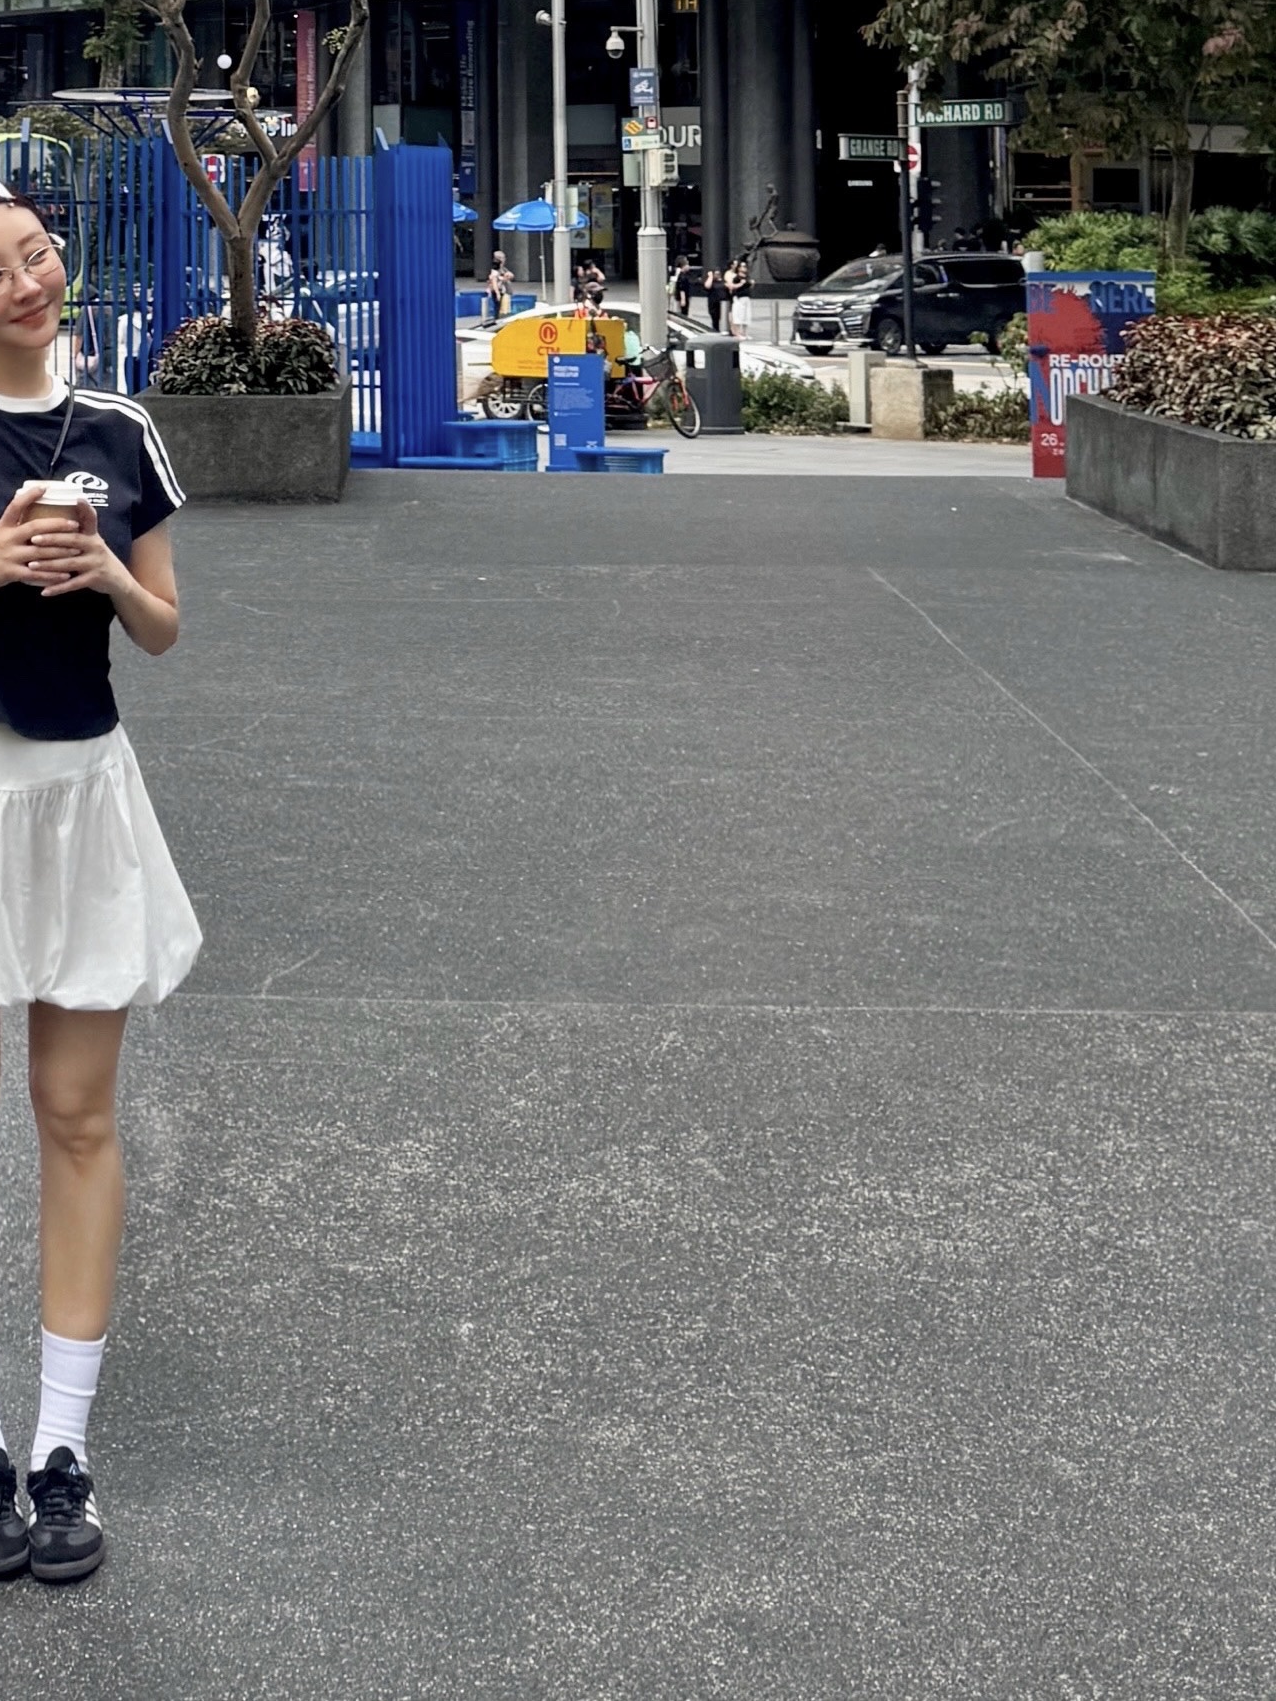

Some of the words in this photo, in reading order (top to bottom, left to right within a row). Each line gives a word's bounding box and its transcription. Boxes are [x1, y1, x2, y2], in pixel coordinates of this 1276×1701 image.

[984, 102, 1004, 121] RD
[849, 139, 885, 157] GRANGE
[887, 139, 899, 157] RD
[1049, 353, 1128, 368] RE-ROUT
